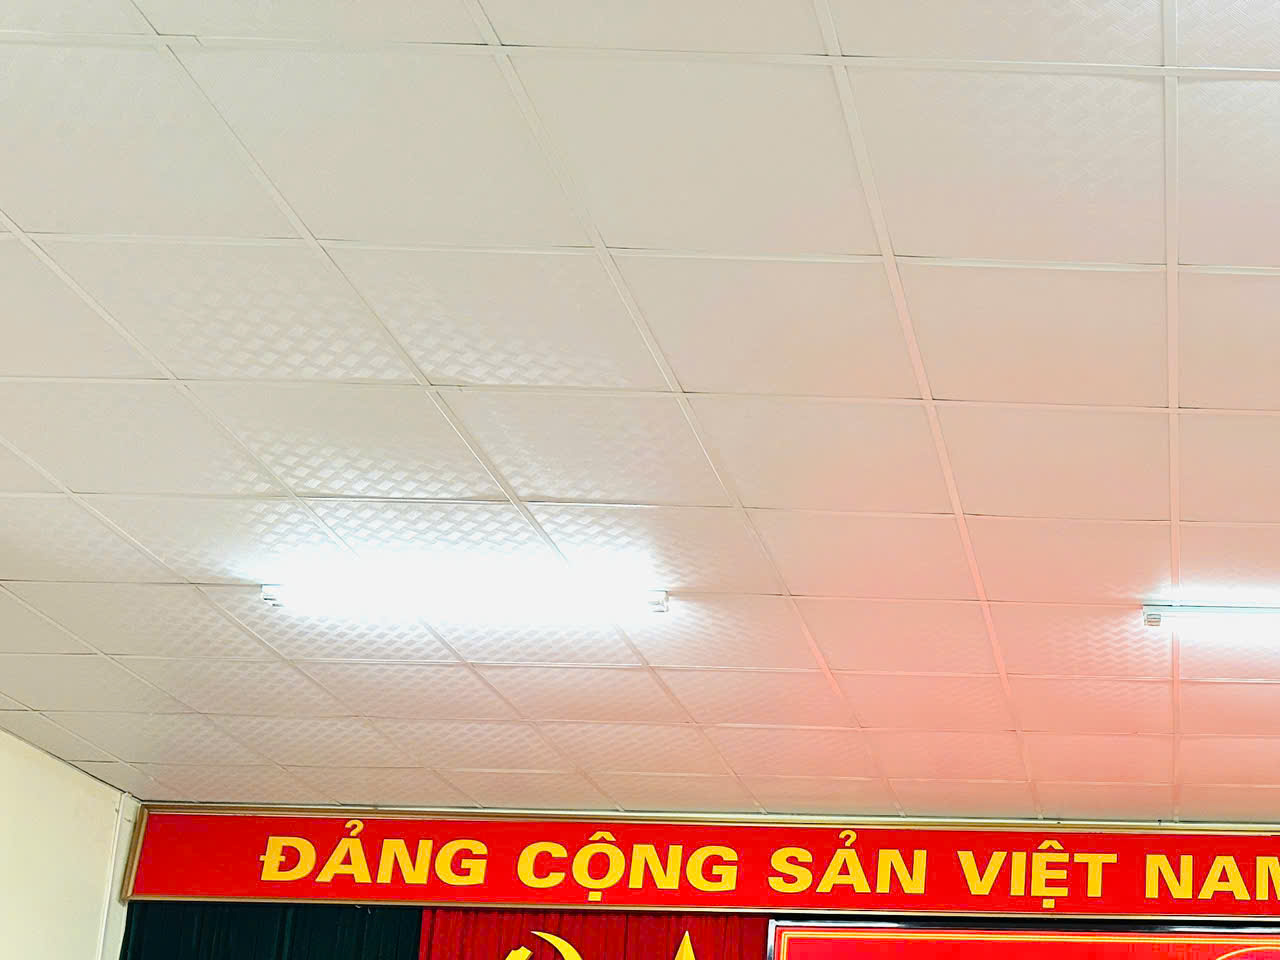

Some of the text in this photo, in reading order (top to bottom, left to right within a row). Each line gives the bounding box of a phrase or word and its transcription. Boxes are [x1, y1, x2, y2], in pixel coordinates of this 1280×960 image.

[259, 819, 488, 886] ĐẢNG
[516, 831, 739, 902] CỘNG
[767, 829, 928, 894] SẢN
[957, 839, 1118, 909] VIỆT
